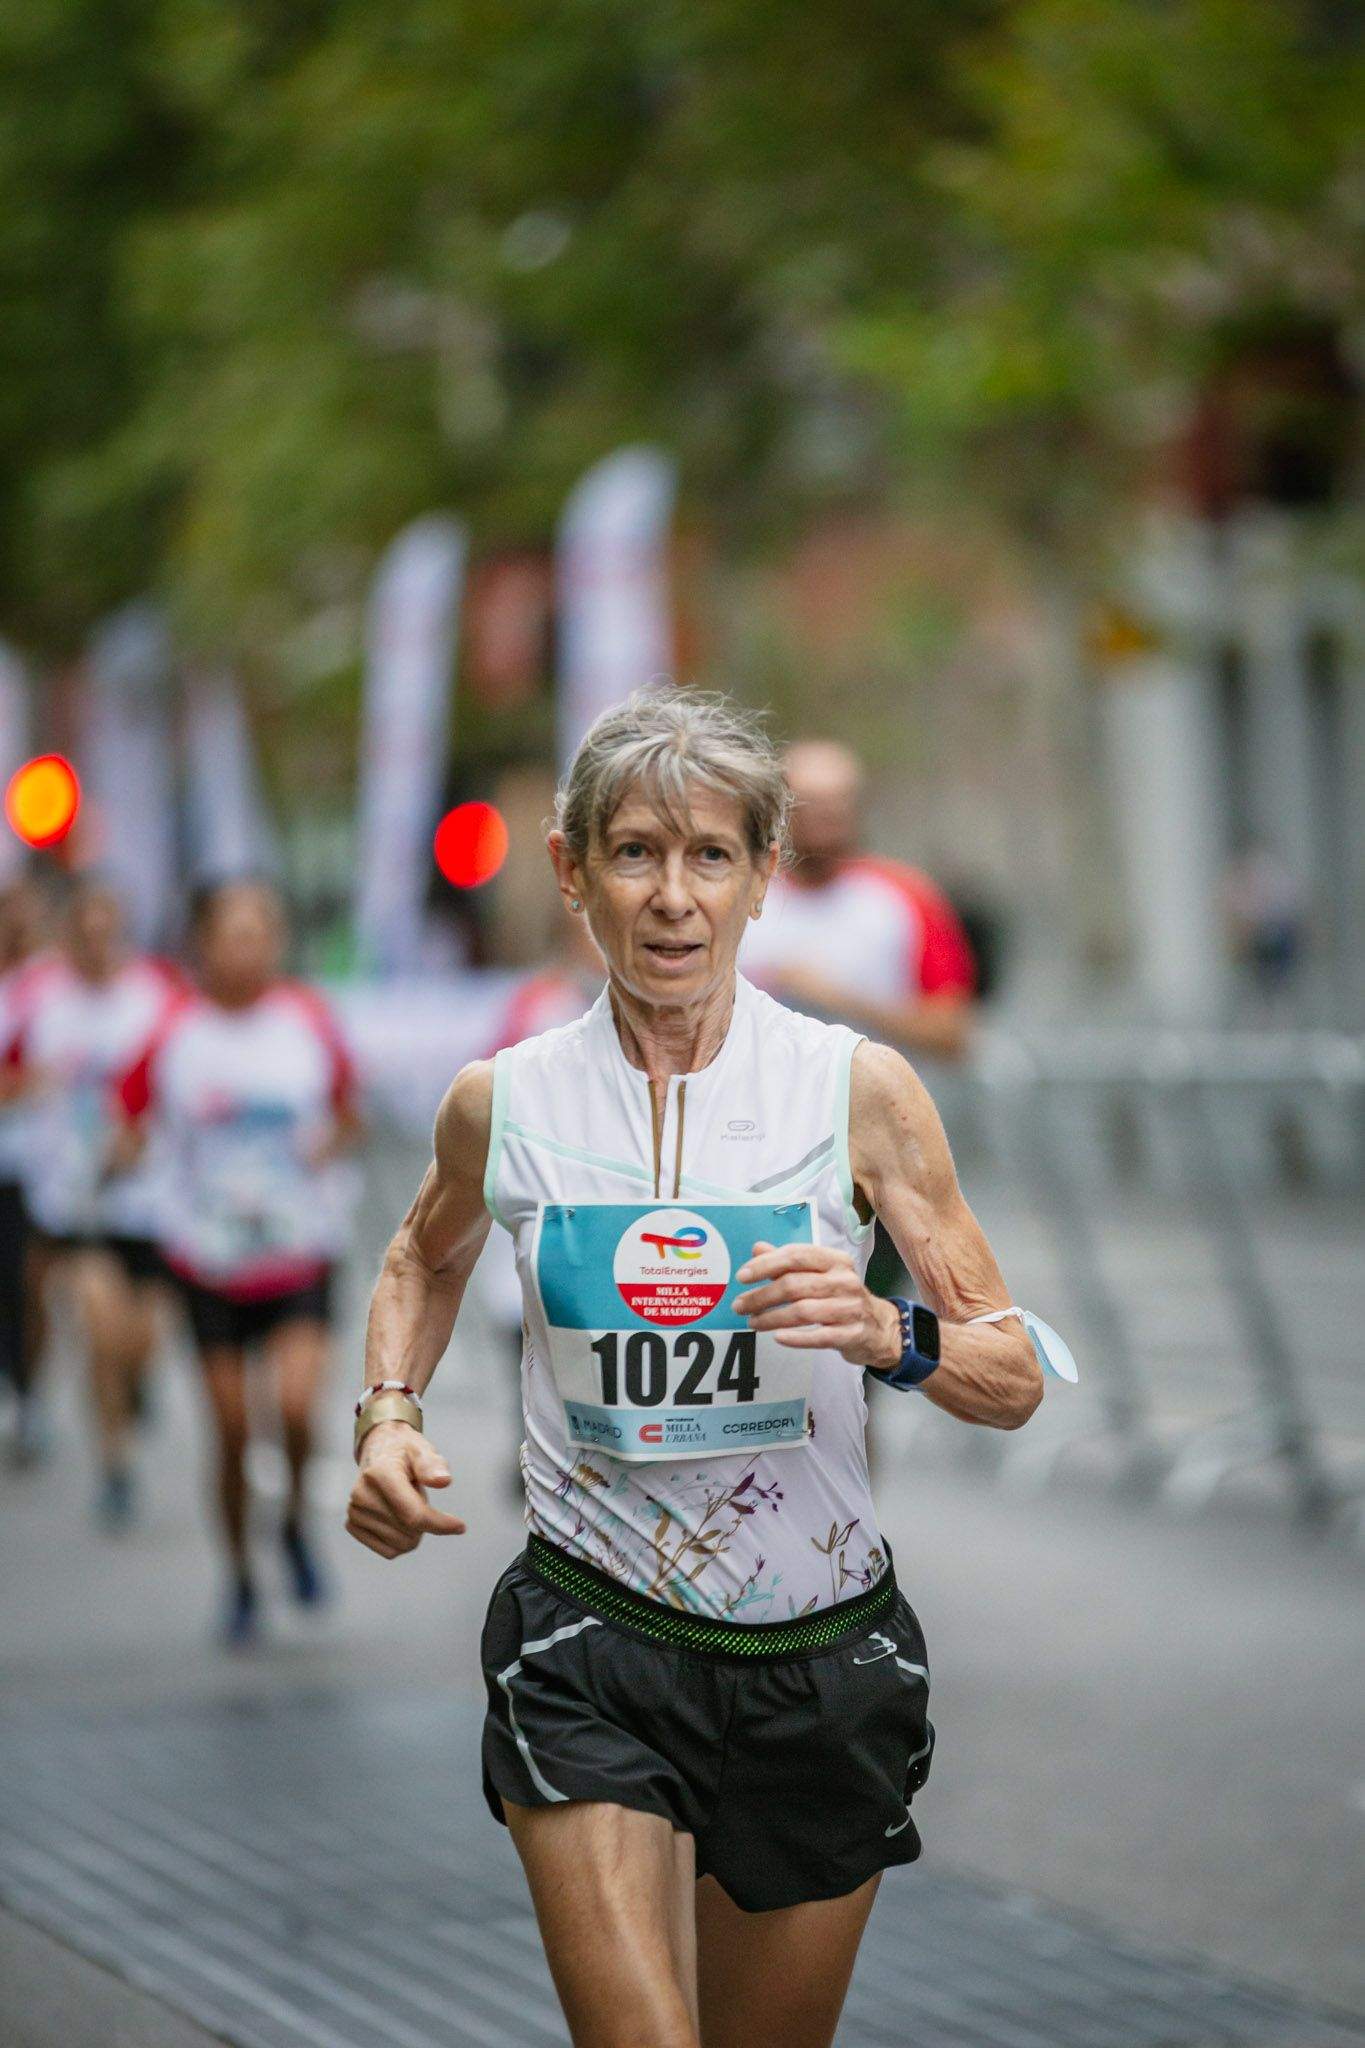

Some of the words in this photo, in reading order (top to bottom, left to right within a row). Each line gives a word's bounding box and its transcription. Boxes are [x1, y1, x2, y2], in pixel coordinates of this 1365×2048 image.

[640, 1266, 709, 1277] TotalEnergies
[656, 1286, 690, 1296] MILLA
[643, 1306, 660, 1316] DE
[660, 1306, 702, 1316] MADRID
[590, 1331, 760, 1408] 1024
[665, 1423, 701, 1433] MILLA
